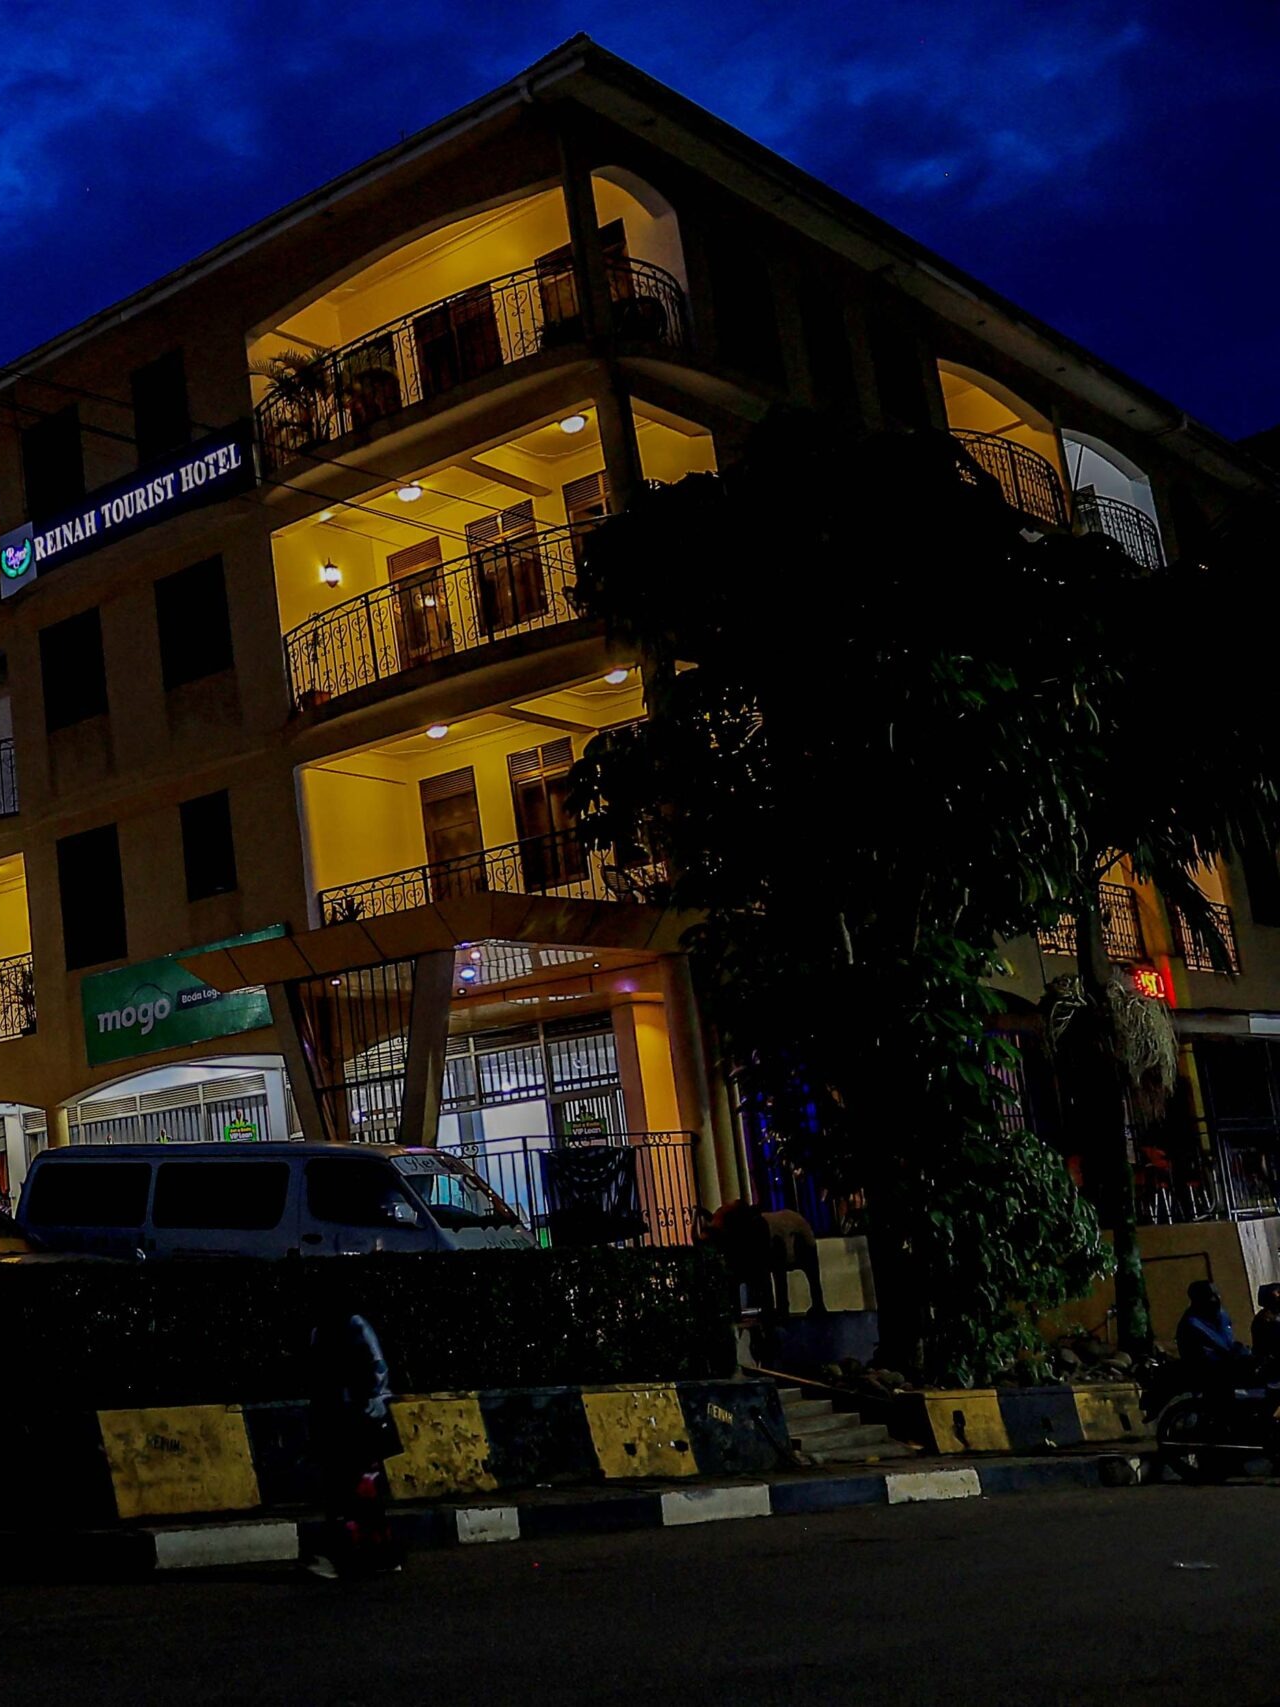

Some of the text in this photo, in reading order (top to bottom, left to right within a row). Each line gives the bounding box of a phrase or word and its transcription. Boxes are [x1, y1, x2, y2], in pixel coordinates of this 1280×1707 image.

[33, 509, 97, 562] REINAH
[100, 472, 175, 529] TOURIST
[179, 442, 242, 494] HOTEL
[97, 997, 172, 1036] mogo
[181, 992, 202, 1004] Boda
